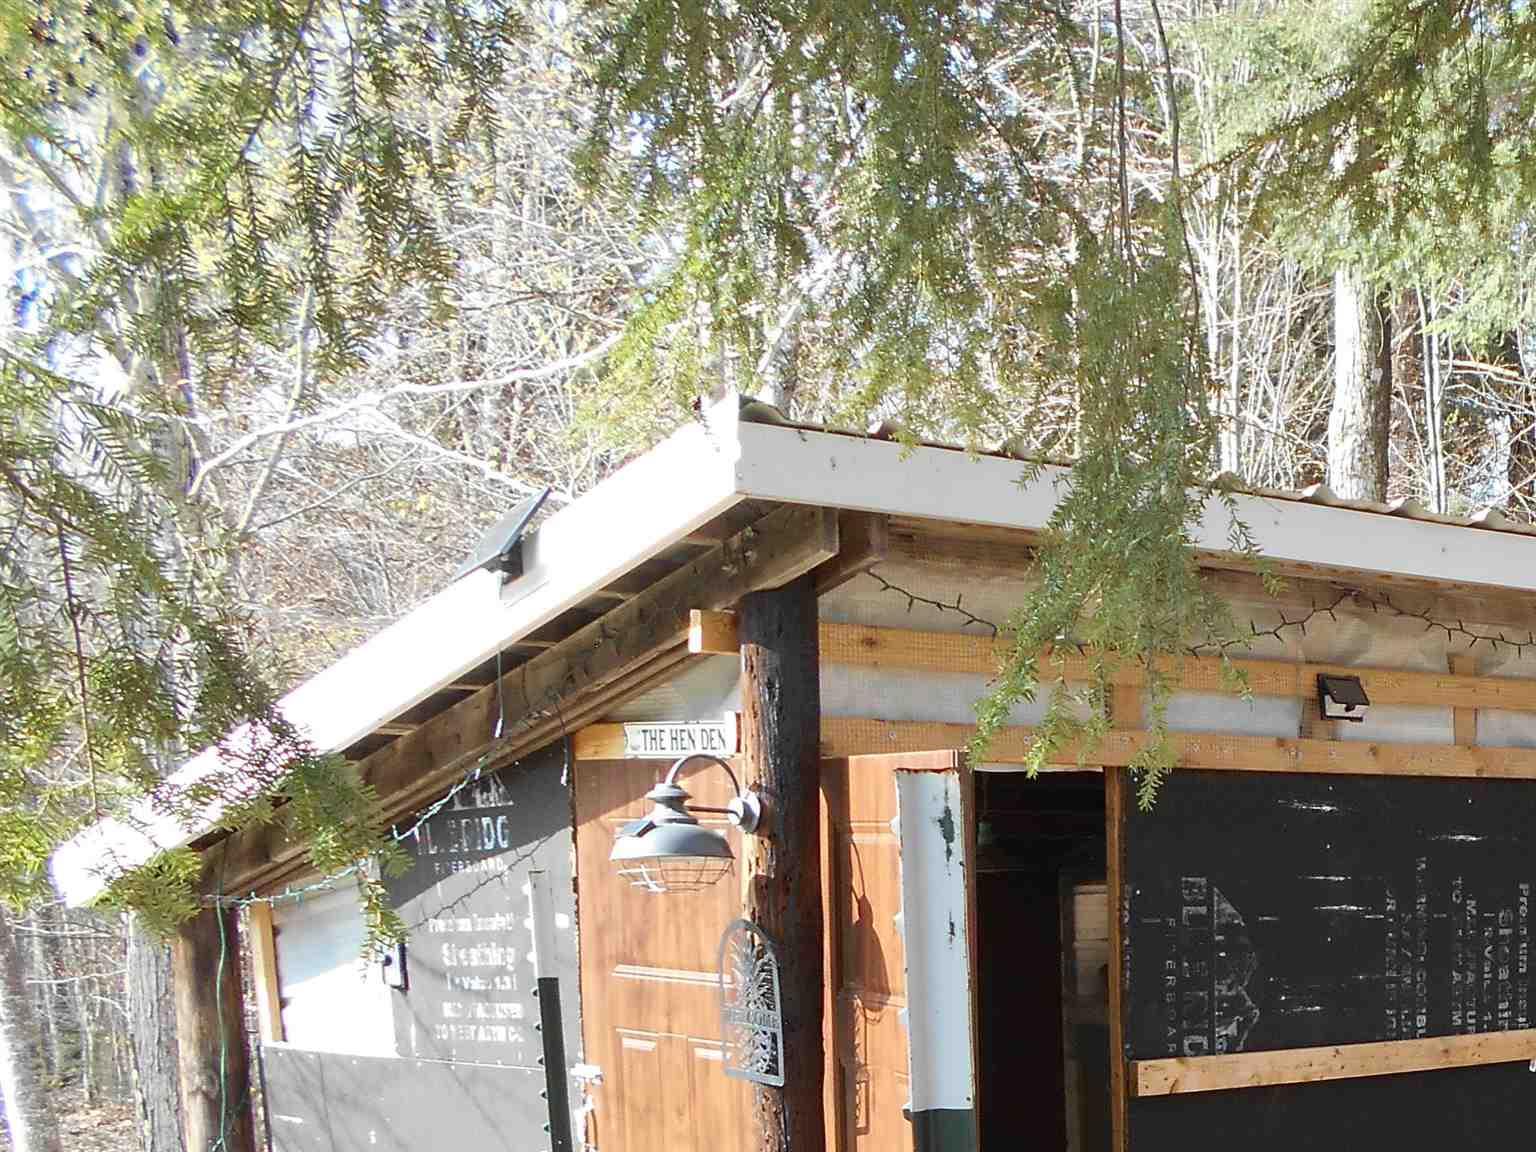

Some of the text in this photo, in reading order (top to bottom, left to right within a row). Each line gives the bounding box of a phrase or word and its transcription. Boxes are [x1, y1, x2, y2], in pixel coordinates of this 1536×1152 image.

[641, 728, 727, 752] THE HEN DEN
